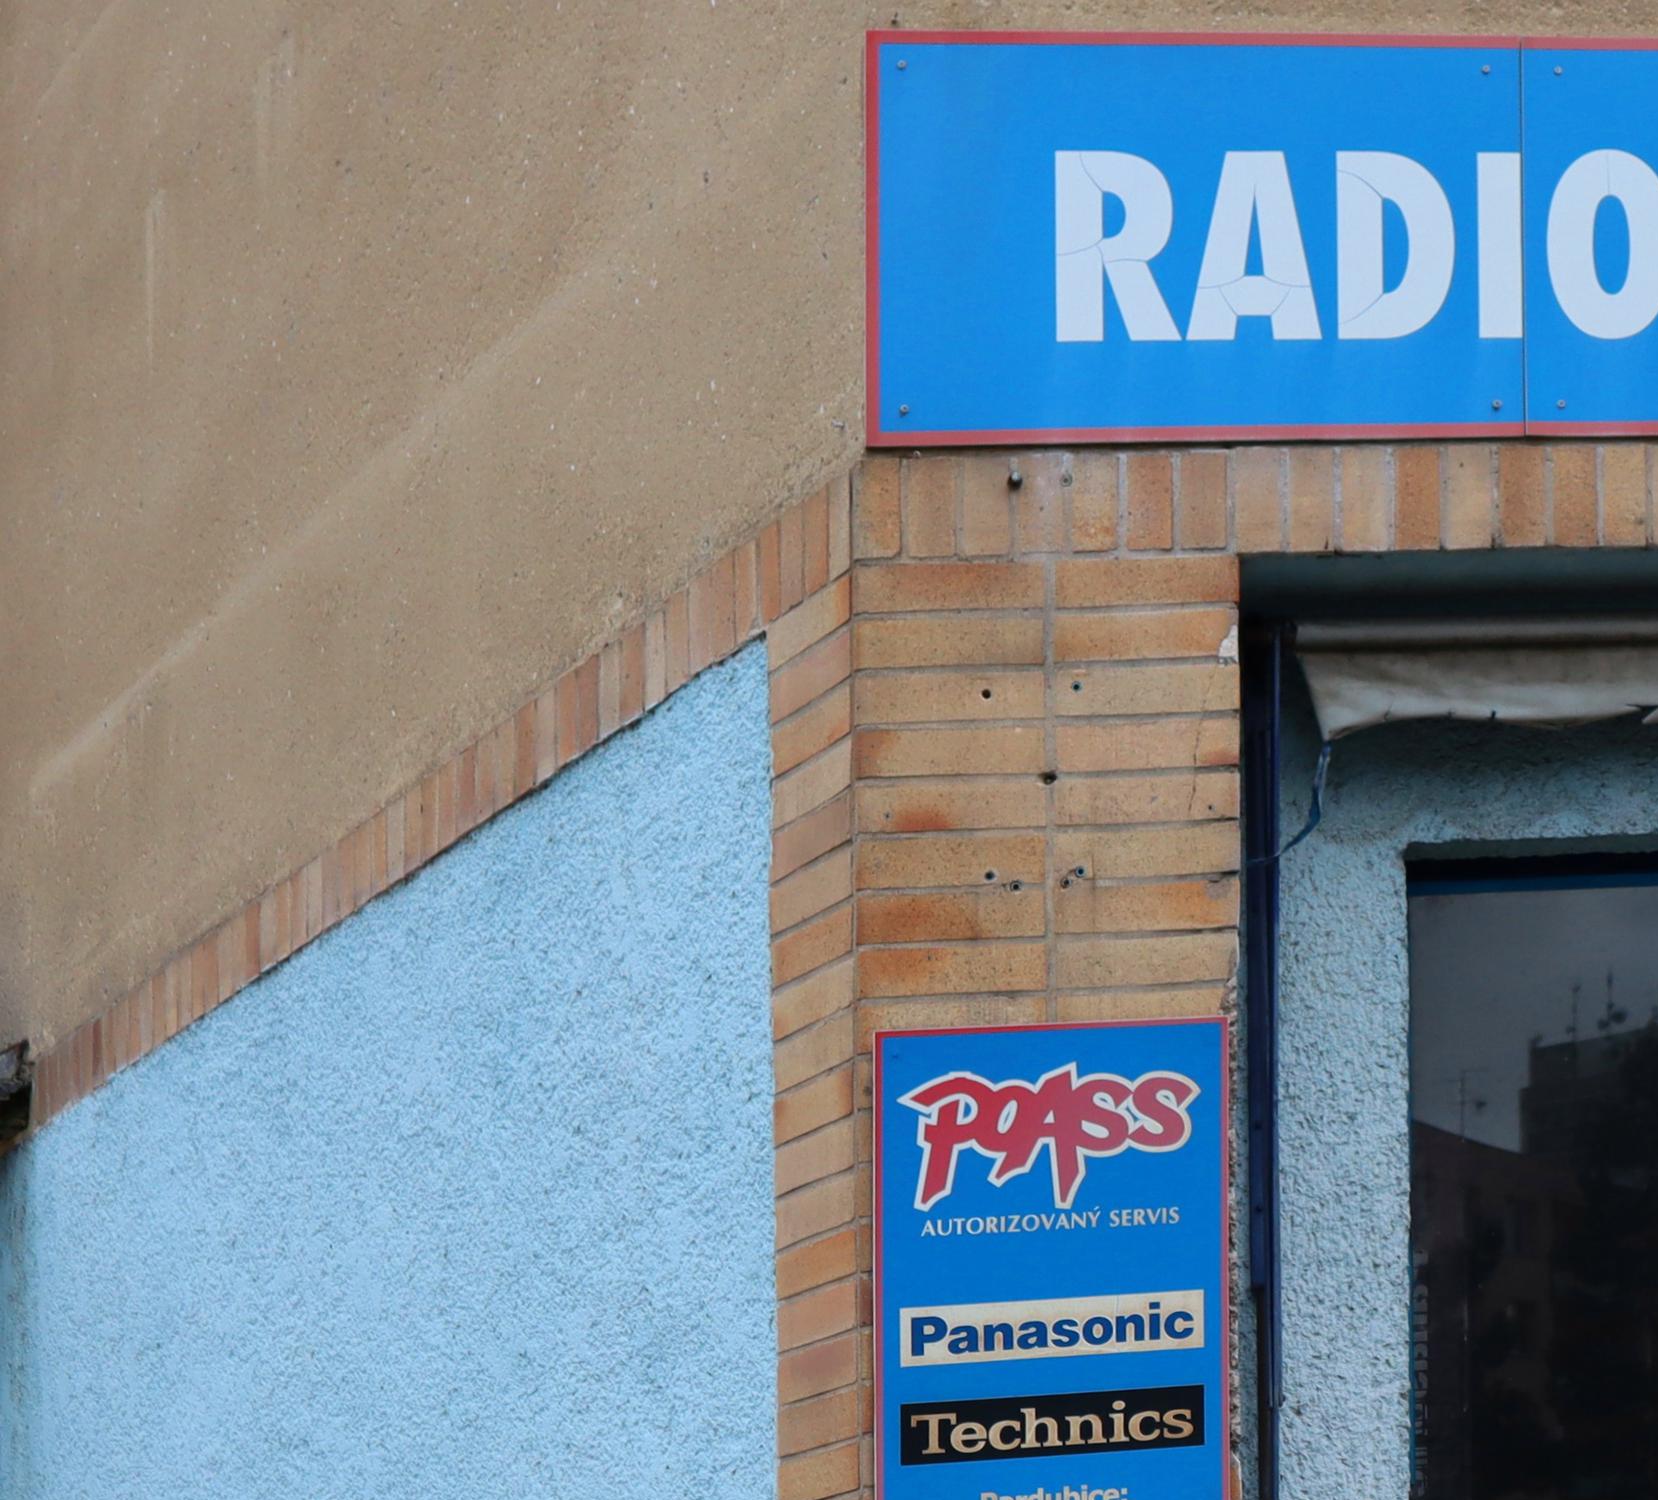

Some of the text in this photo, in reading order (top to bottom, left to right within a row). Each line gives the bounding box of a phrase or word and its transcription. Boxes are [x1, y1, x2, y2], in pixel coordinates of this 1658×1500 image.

[897, 1061, 1201, 1212] POASS
[921, 1206, 1180, 1237] AUTORIZOVANÝ SERVIS
[910, 1301, 1195, 1357] Panasonic
[911, 1401, 1195, 1455] Technics
